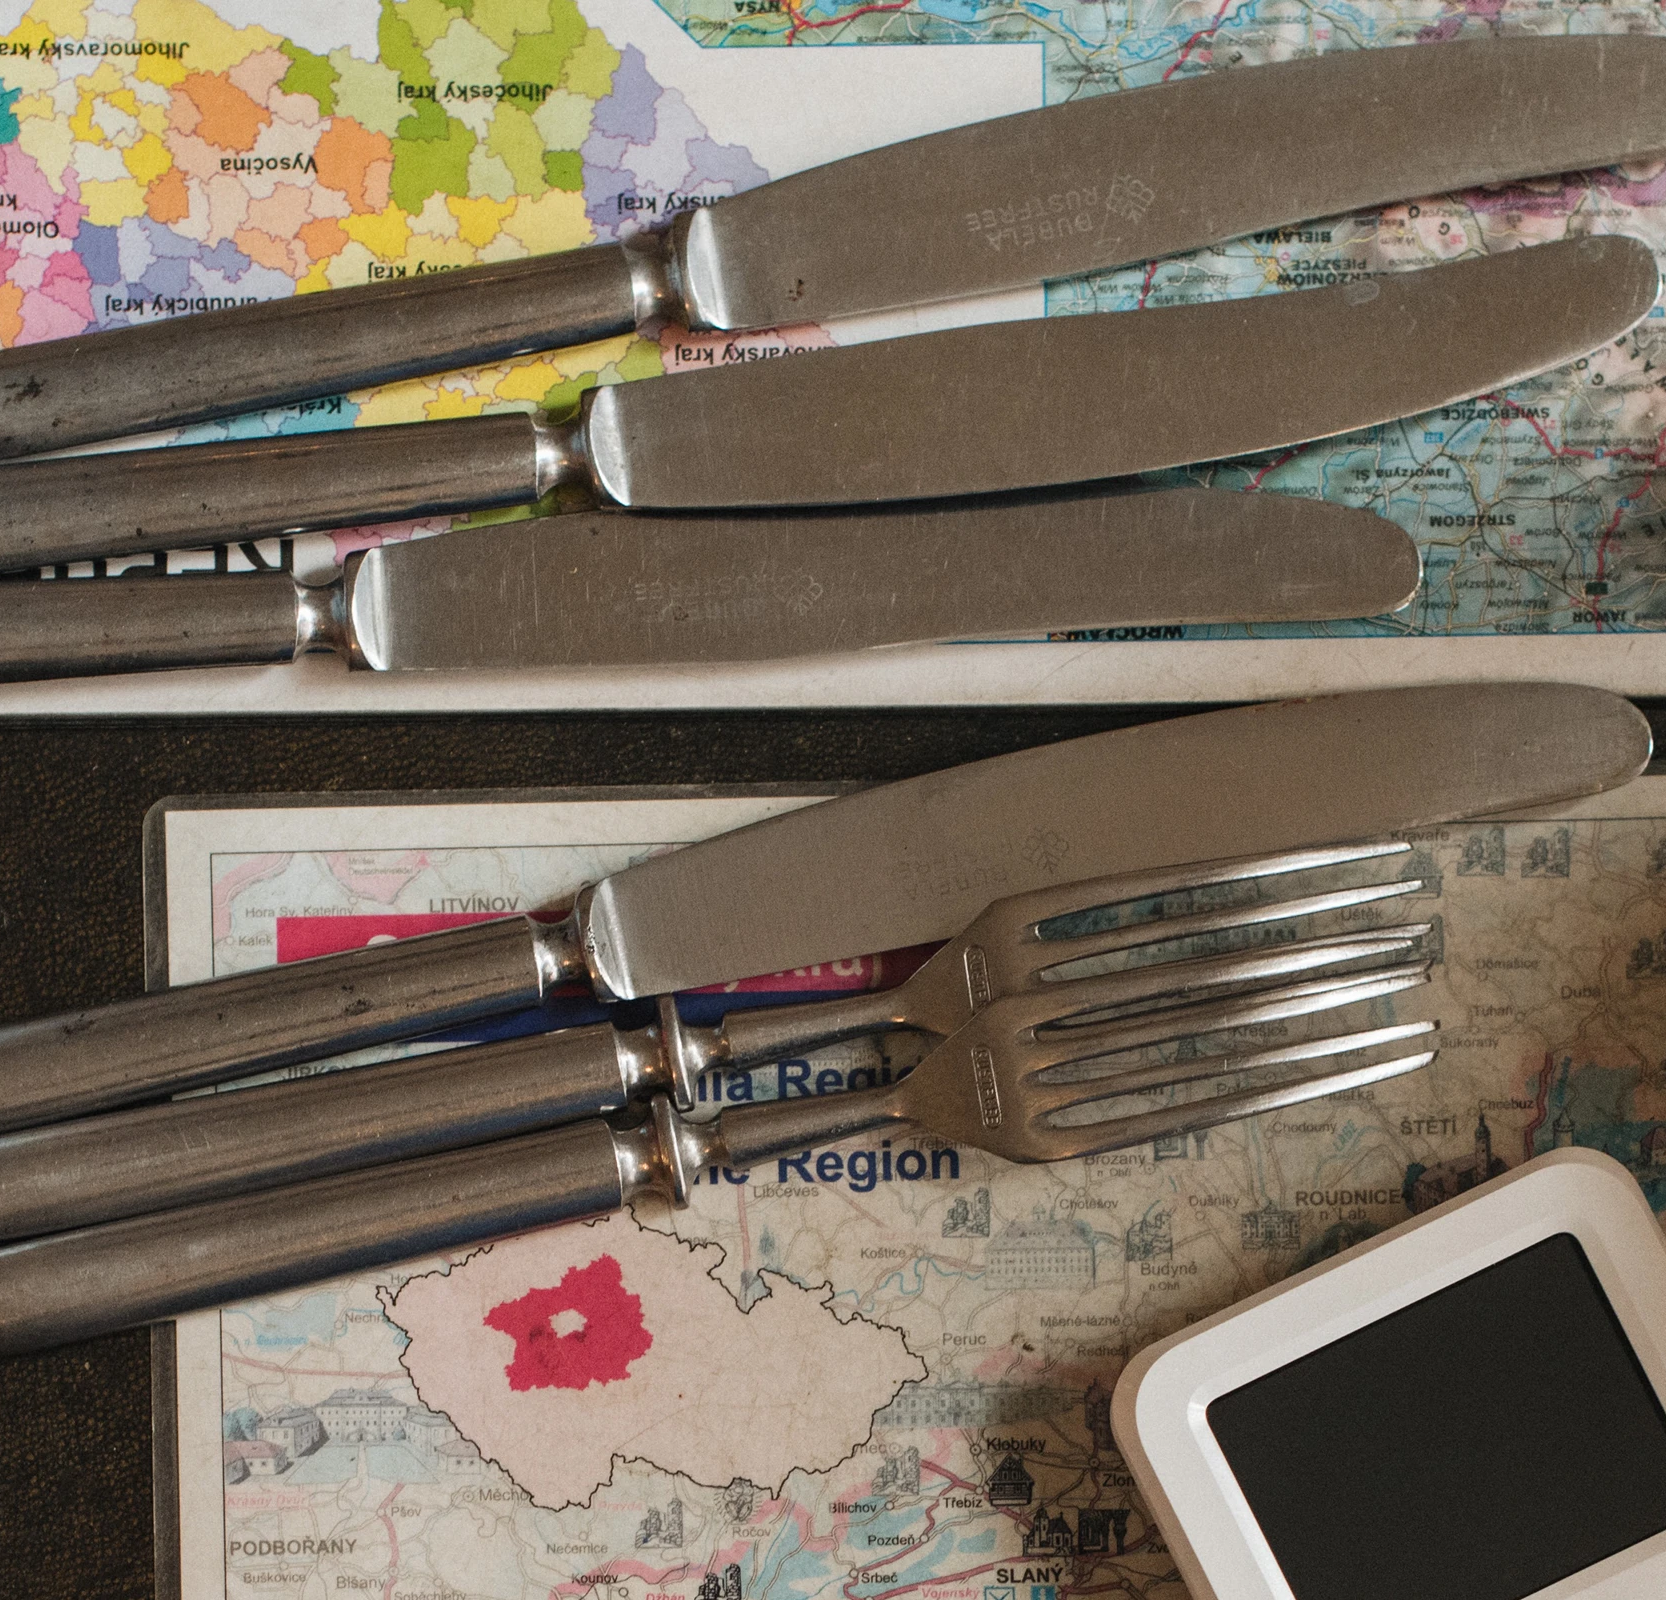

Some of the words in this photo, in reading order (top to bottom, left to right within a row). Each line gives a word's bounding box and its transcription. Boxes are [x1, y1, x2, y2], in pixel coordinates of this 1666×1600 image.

[39, 34, 190, 61] Jihomoravský
[397, 77, 438, 105] kraj
[444, 77, 554, 105] Jihočeský
[219, 149, 319, 178] Vysočina
[1253, 230, 1332, 244] BIELAWA
[1292, 258, 1367, 271] PIESZYCE
[1376, 465, 1451, 481] Jaworzyna
[1430, 514, 1515, 527] STRZEGOM
[1572, 610, 1626, 623] JAWOR
[428, 893, 521, 915] LITVÍNOV
[1401, 1117, 1456, 1136] ŠTĚTÍ
[778, 1140, 961, 1194] Region
[1296, 1189, 1401, 1206] ROUDNICE
[987, 1437, 1046, 1454] Klobuky
[230, 1537, 357, 1557] PODBOŘANY
[997, 1563, 1063, 1584] SLANÝ
